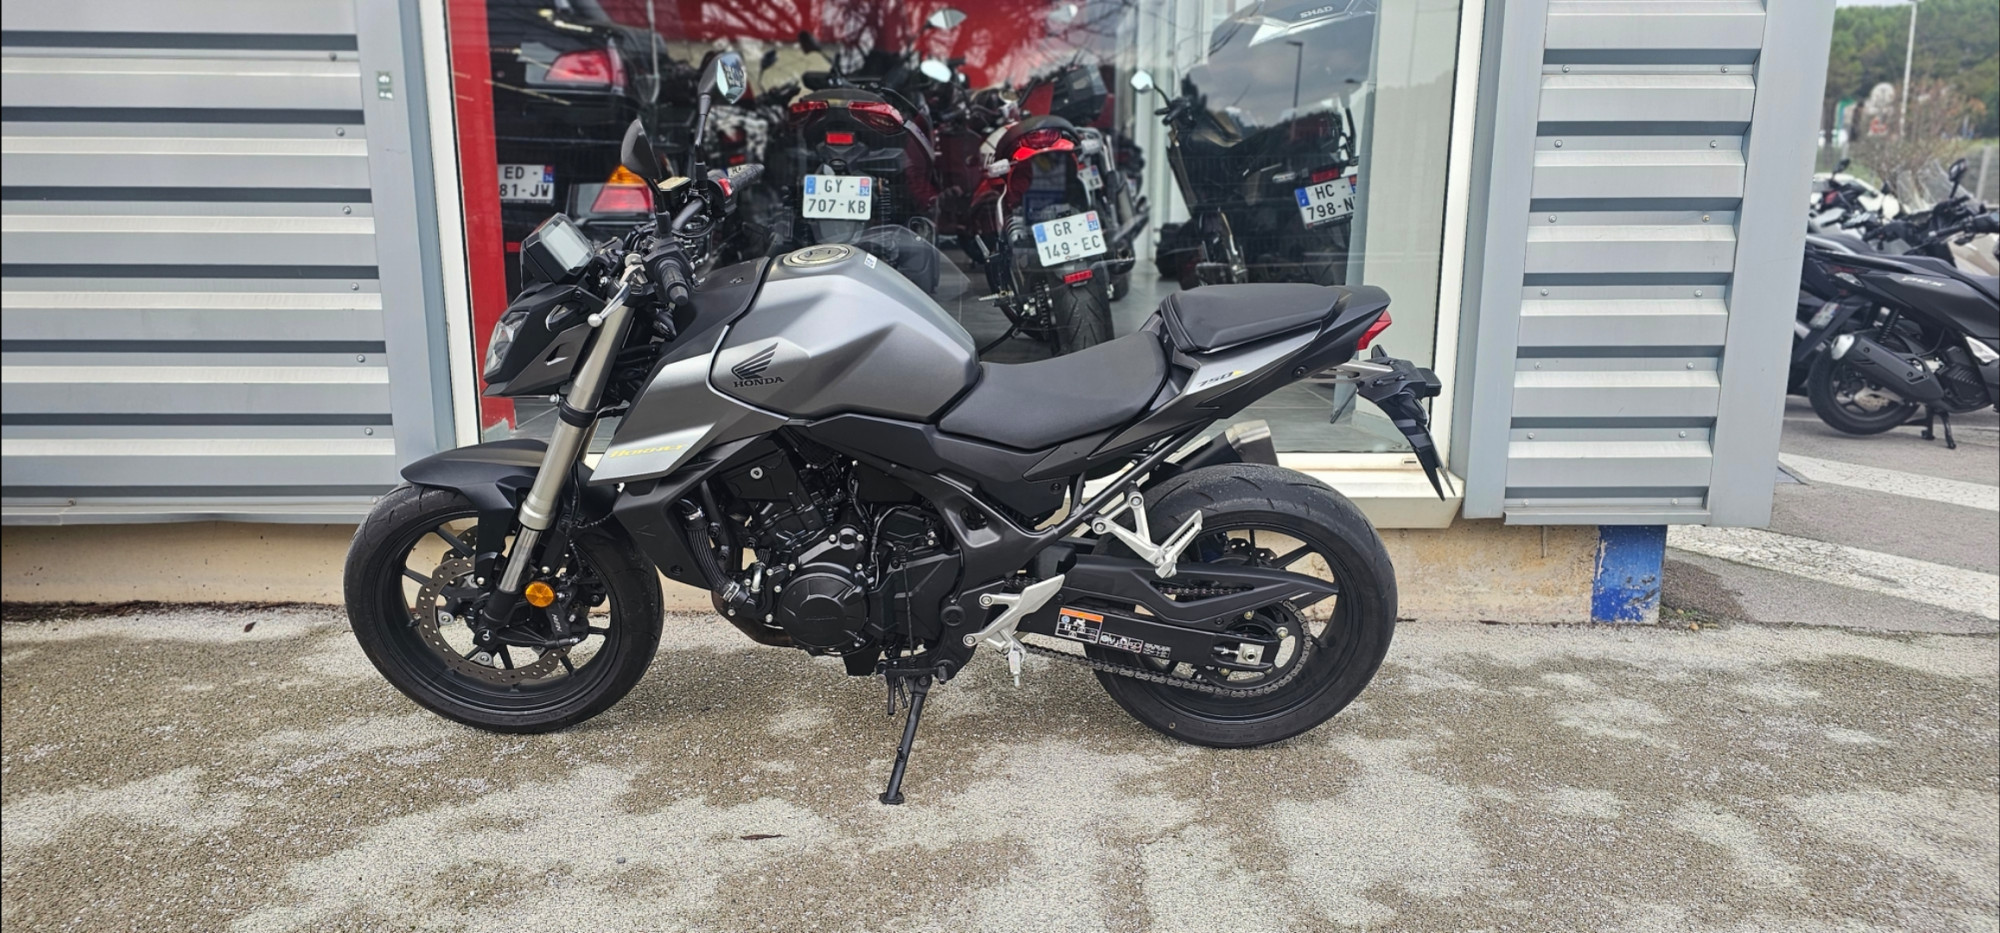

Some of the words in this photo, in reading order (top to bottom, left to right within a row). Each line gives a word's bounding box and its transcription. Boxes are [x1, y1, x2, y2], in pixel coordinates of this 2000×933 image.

[1300, 6, 1333, 18] SHAD
[504, 166, 525, 179] ED
[824, 180, 842, 192] GY
[1315, 184, 1334, 199] HC
[1306, 196, 1355, 220] 798-N
[1053, 221, 1072, 236] GR
[733, 376, 784, 387] HONDA
[1199, 371, 1234, 387] 750
